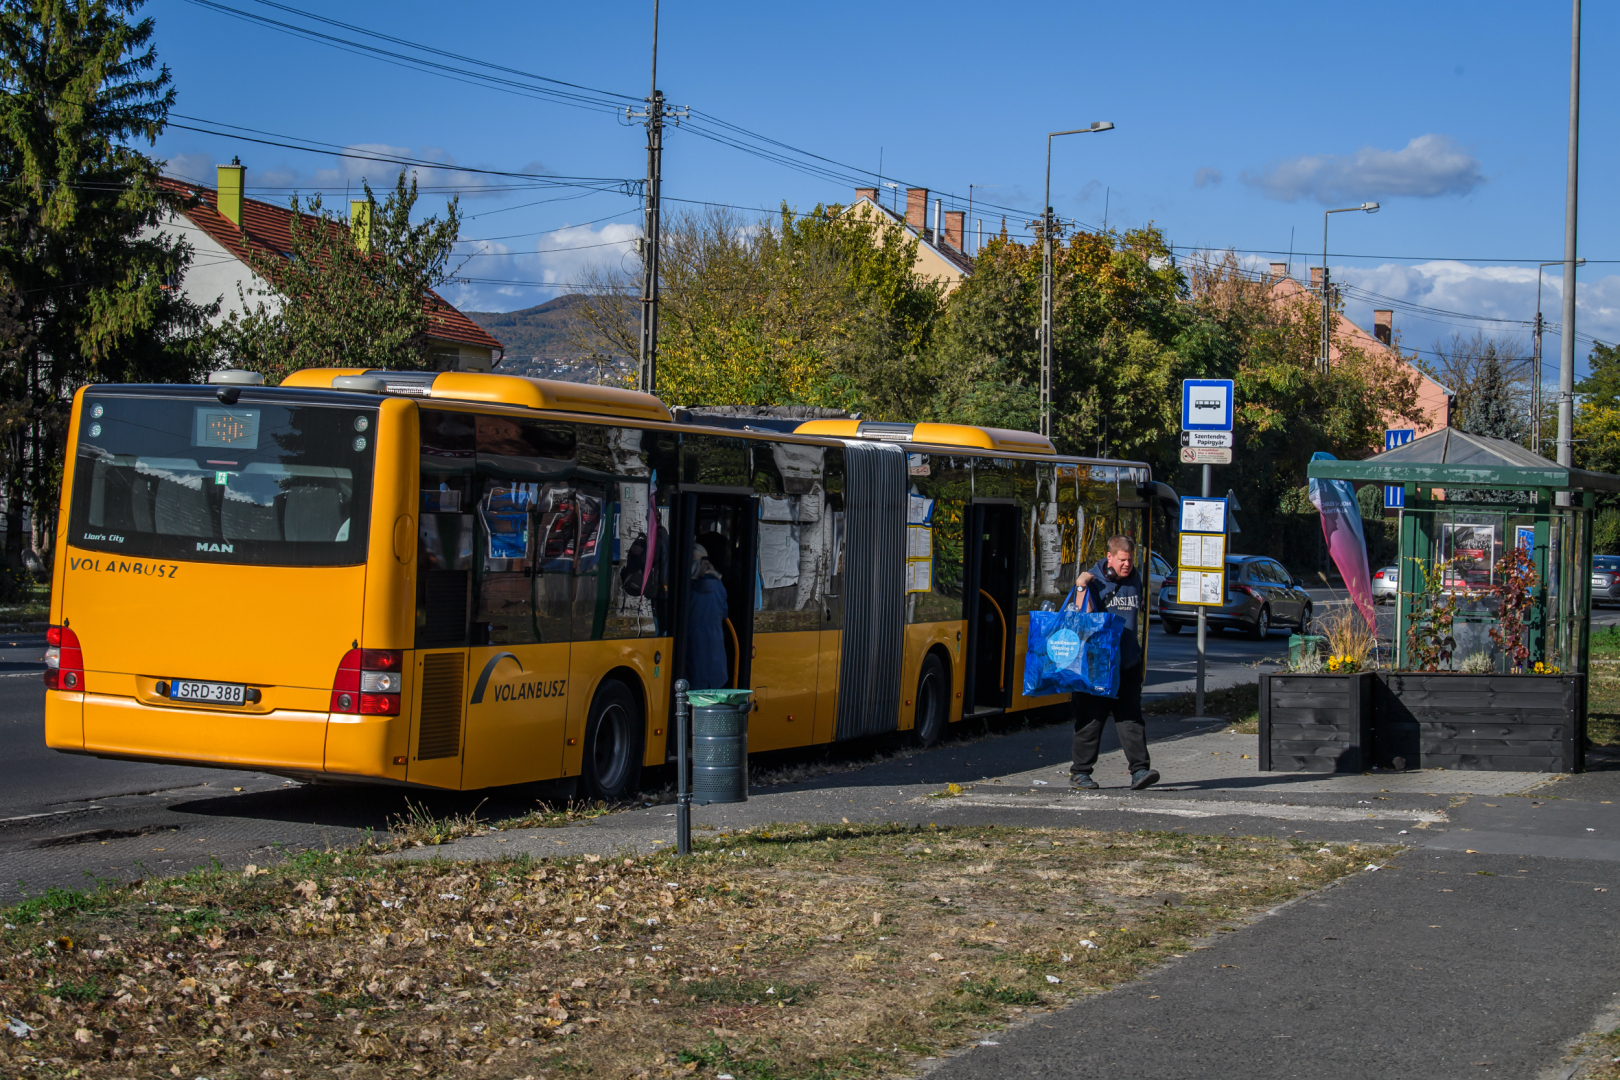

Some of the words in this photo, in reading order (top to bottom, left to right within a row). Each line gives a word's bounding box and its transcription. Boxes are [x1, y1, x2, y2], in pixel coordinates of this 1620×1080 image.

[83, 532, 106, 541] Lion's
[108, 534, 125, 543] City
[196, 542, 234, 553] MAN
[180, 683, 241, 701] SRD-388
